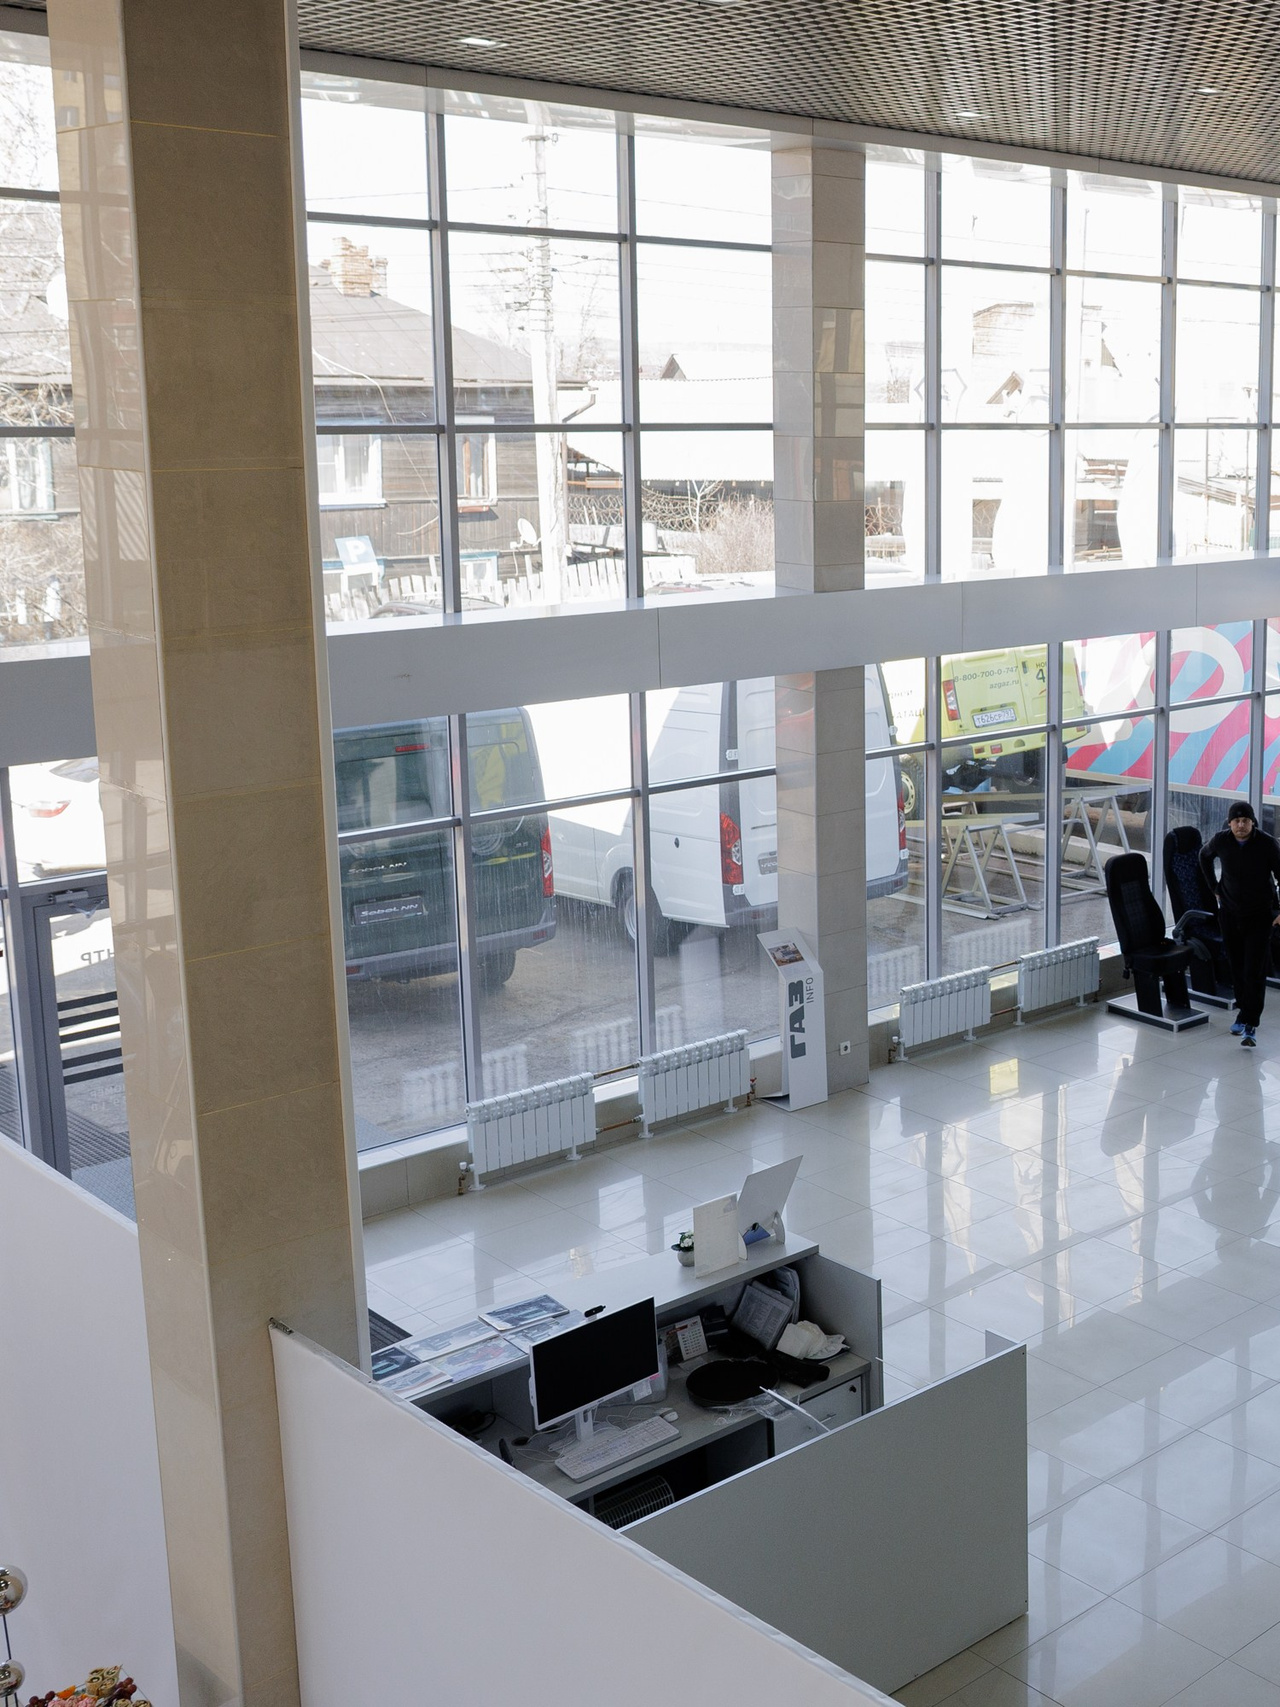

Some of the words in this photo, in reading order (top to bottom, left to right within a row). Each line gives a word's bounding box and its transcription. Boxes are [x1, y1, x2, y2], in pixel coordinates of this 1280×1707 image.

[345, 540, 366, 563] P
[954, 666, 1019, 683] 8-800-700-0-747
[989, 679, 1020, 691] azgaz.ru
[805, 976, 814, 1004] INFO
[788, 979, 807, 1059] ГАЗ
